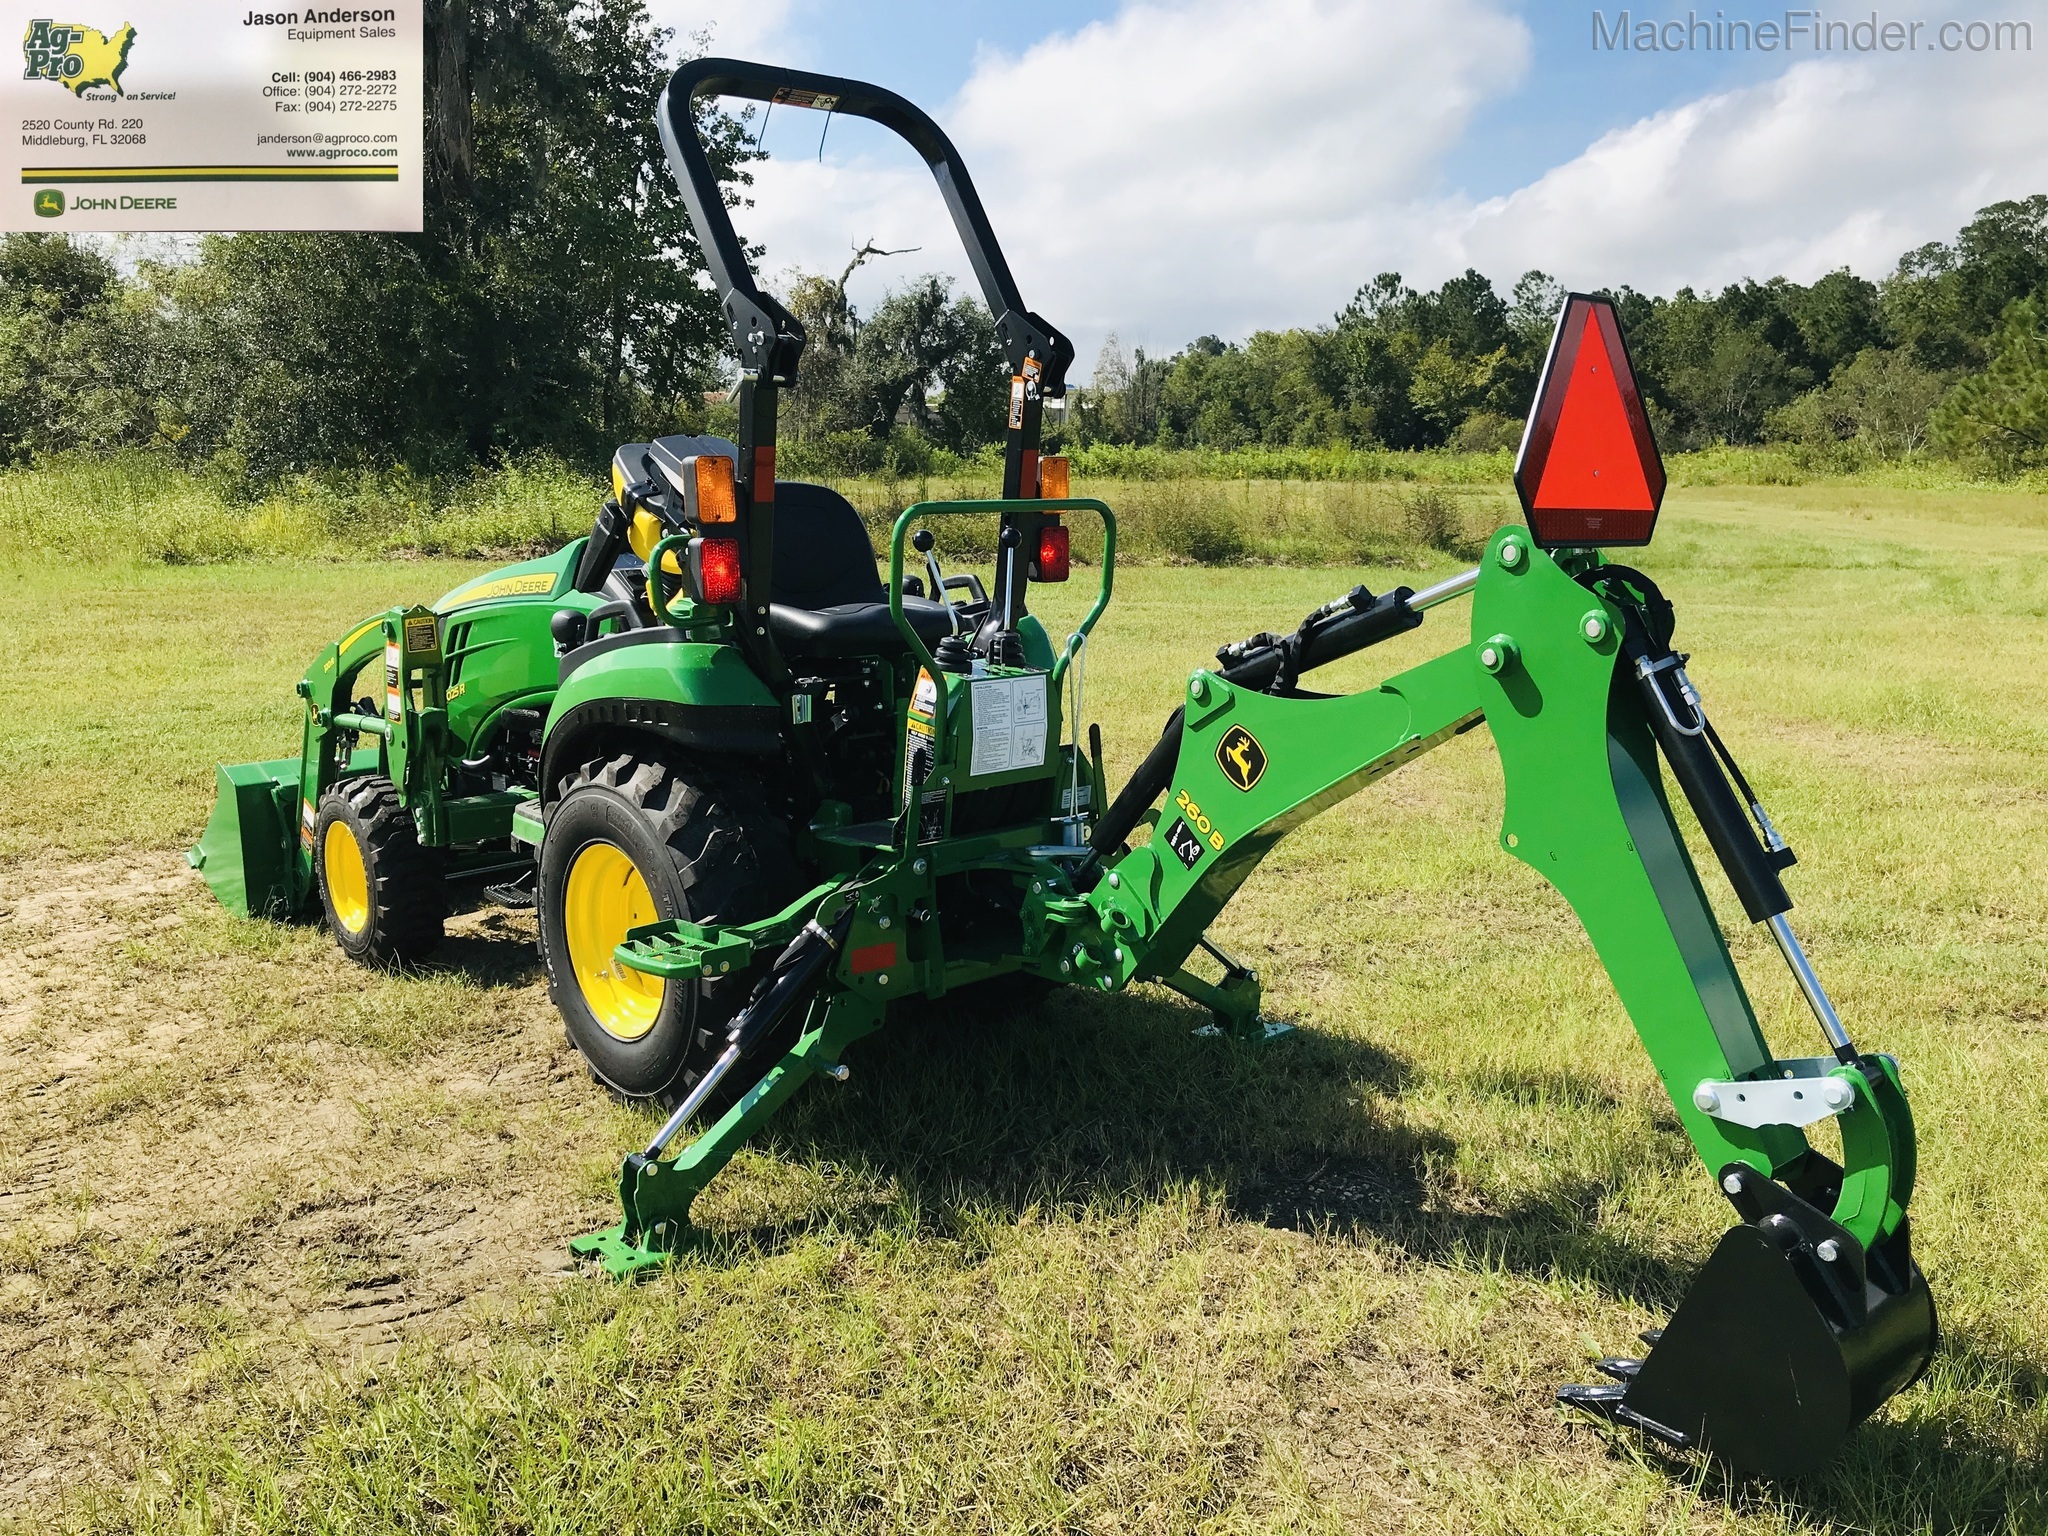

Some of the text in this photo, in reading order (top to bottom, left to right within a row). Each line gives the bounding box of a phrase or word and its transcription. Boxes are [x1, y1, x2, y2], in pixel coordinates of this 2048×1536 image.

[487, 580, 549, 597] JOHN DEERE
[1175, 789, 1225, 852] 260 B
